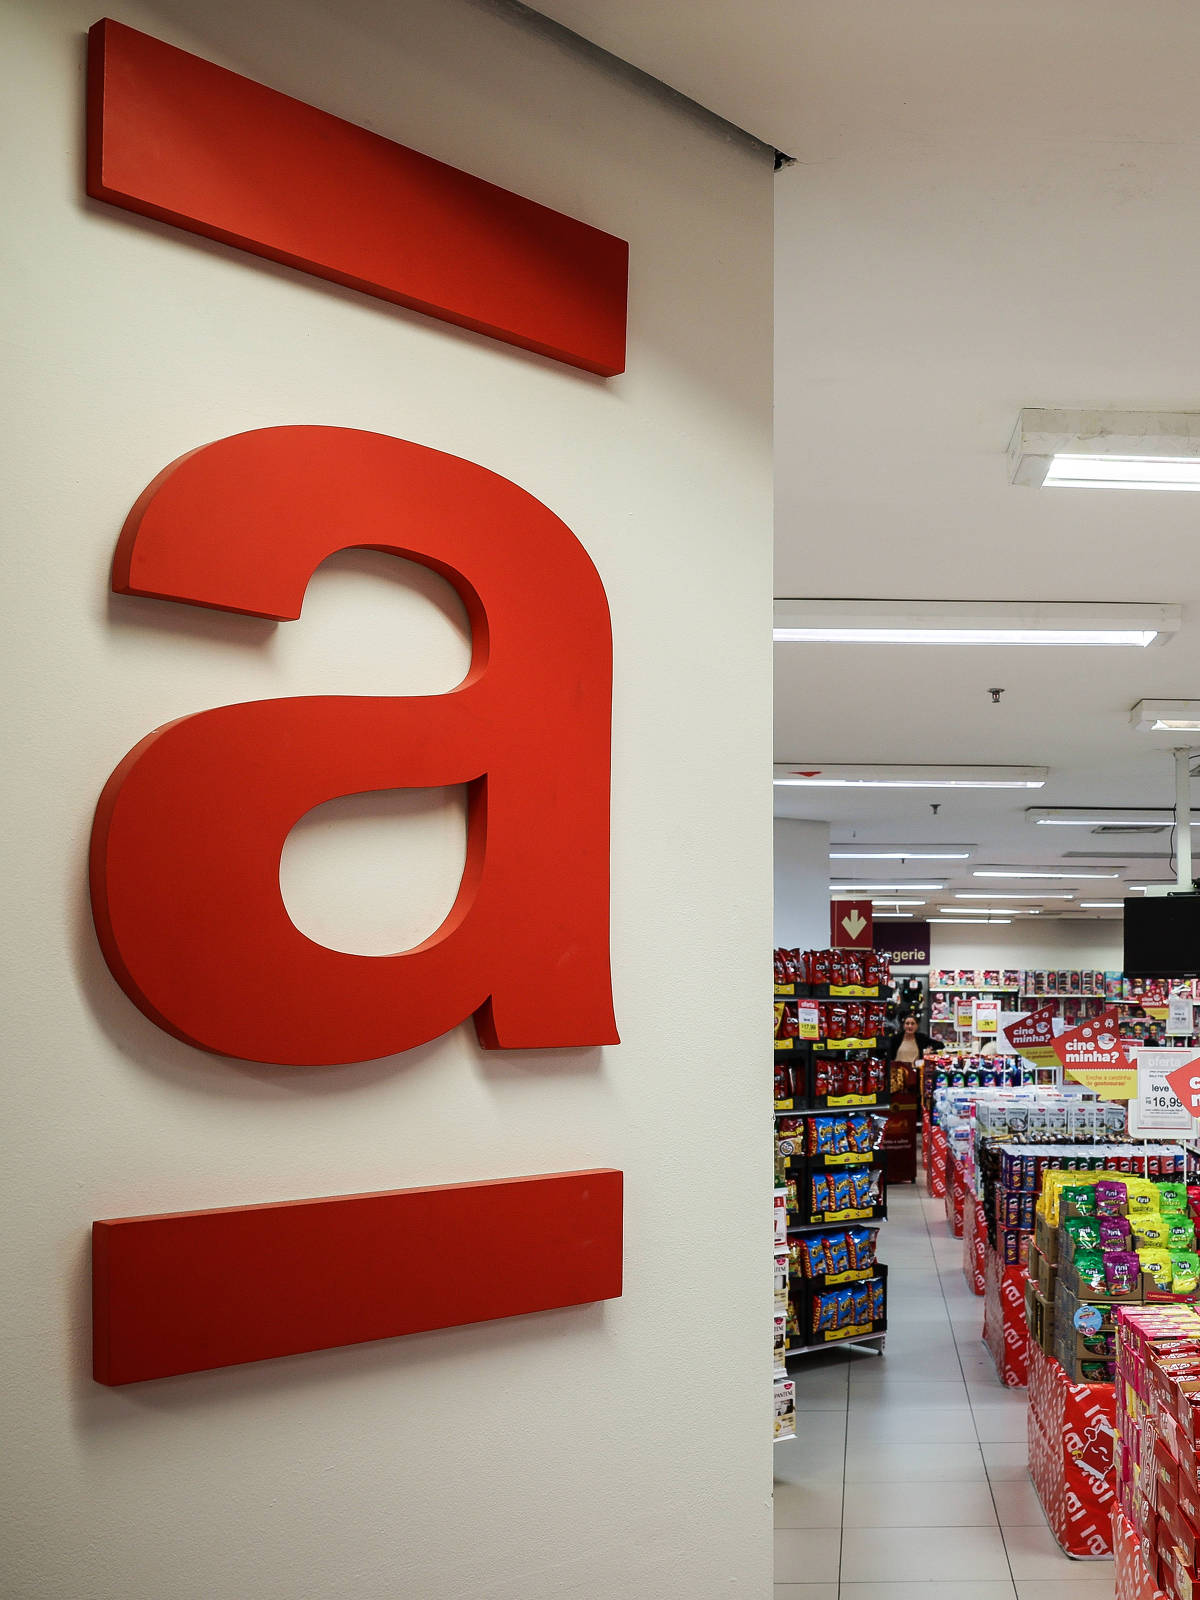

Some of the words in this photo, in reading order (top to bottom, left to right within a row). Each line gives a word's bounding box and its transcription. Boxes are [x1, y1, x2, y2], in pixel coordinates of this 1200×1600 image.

[1013, 1027, 1034, 1035] cine
[1013, 1035, 1050, 1043] minha?
[1065, 1039, 1095, 1051] cine
[1065, 1051, 1119, 1063] minha?
[1152, 1084, 1169, 1092] leve
[1153, 1097, 1183, 1108] 16,99
